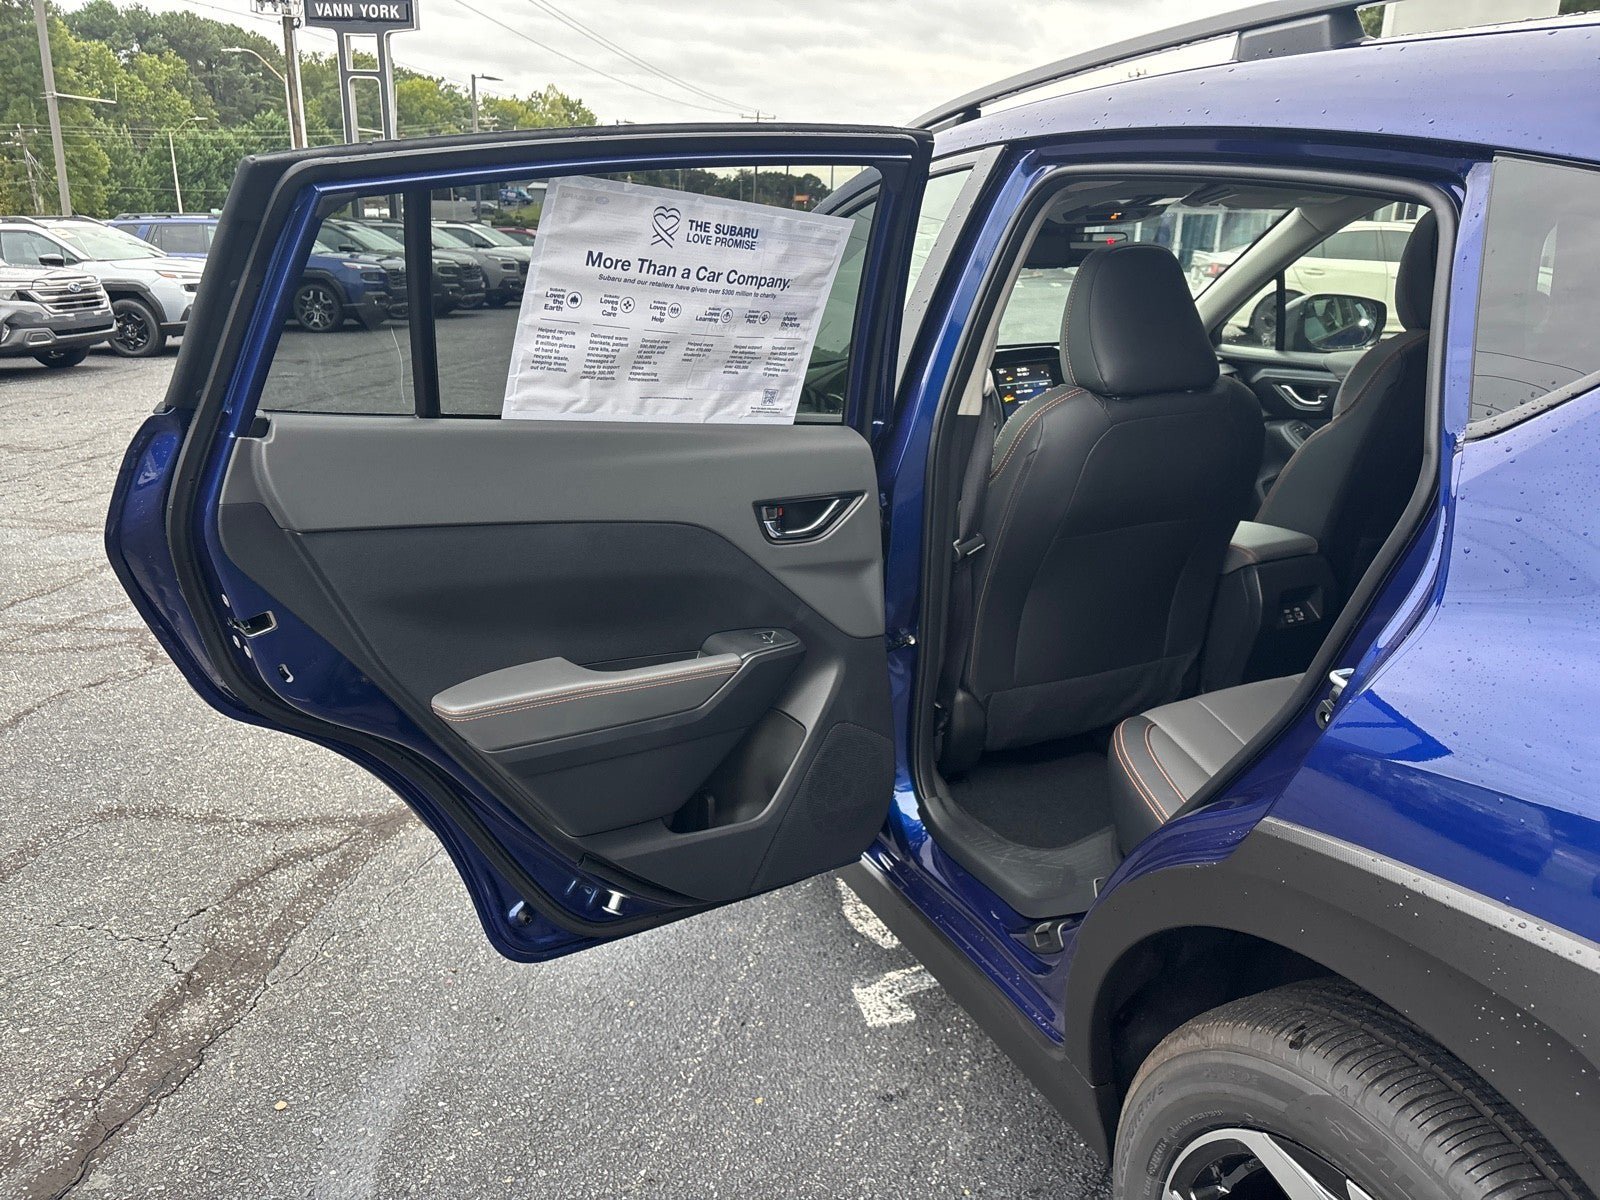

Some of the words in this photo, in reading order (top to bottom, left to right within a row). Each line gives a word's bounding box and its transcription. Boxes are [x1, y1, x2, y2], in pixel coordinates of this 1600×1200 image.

[315, 3, 352, 17] VANN
[360, 4, 399, 18] YORK
[686, 233, 712, 245] LOVE
[689, 219, 711, 233] THE
[714, 224, 759, 239] SUBARU
[585, 251, 631, 271] More
[638, 258, 676, 278] Than
[681, 267, 690, 279] a
[696, 266, 723, 283] Car
[598, 274, 622, 282] Subaru
[649, 280, 674, 289] retailers
[691, 286, 708, 294] given
